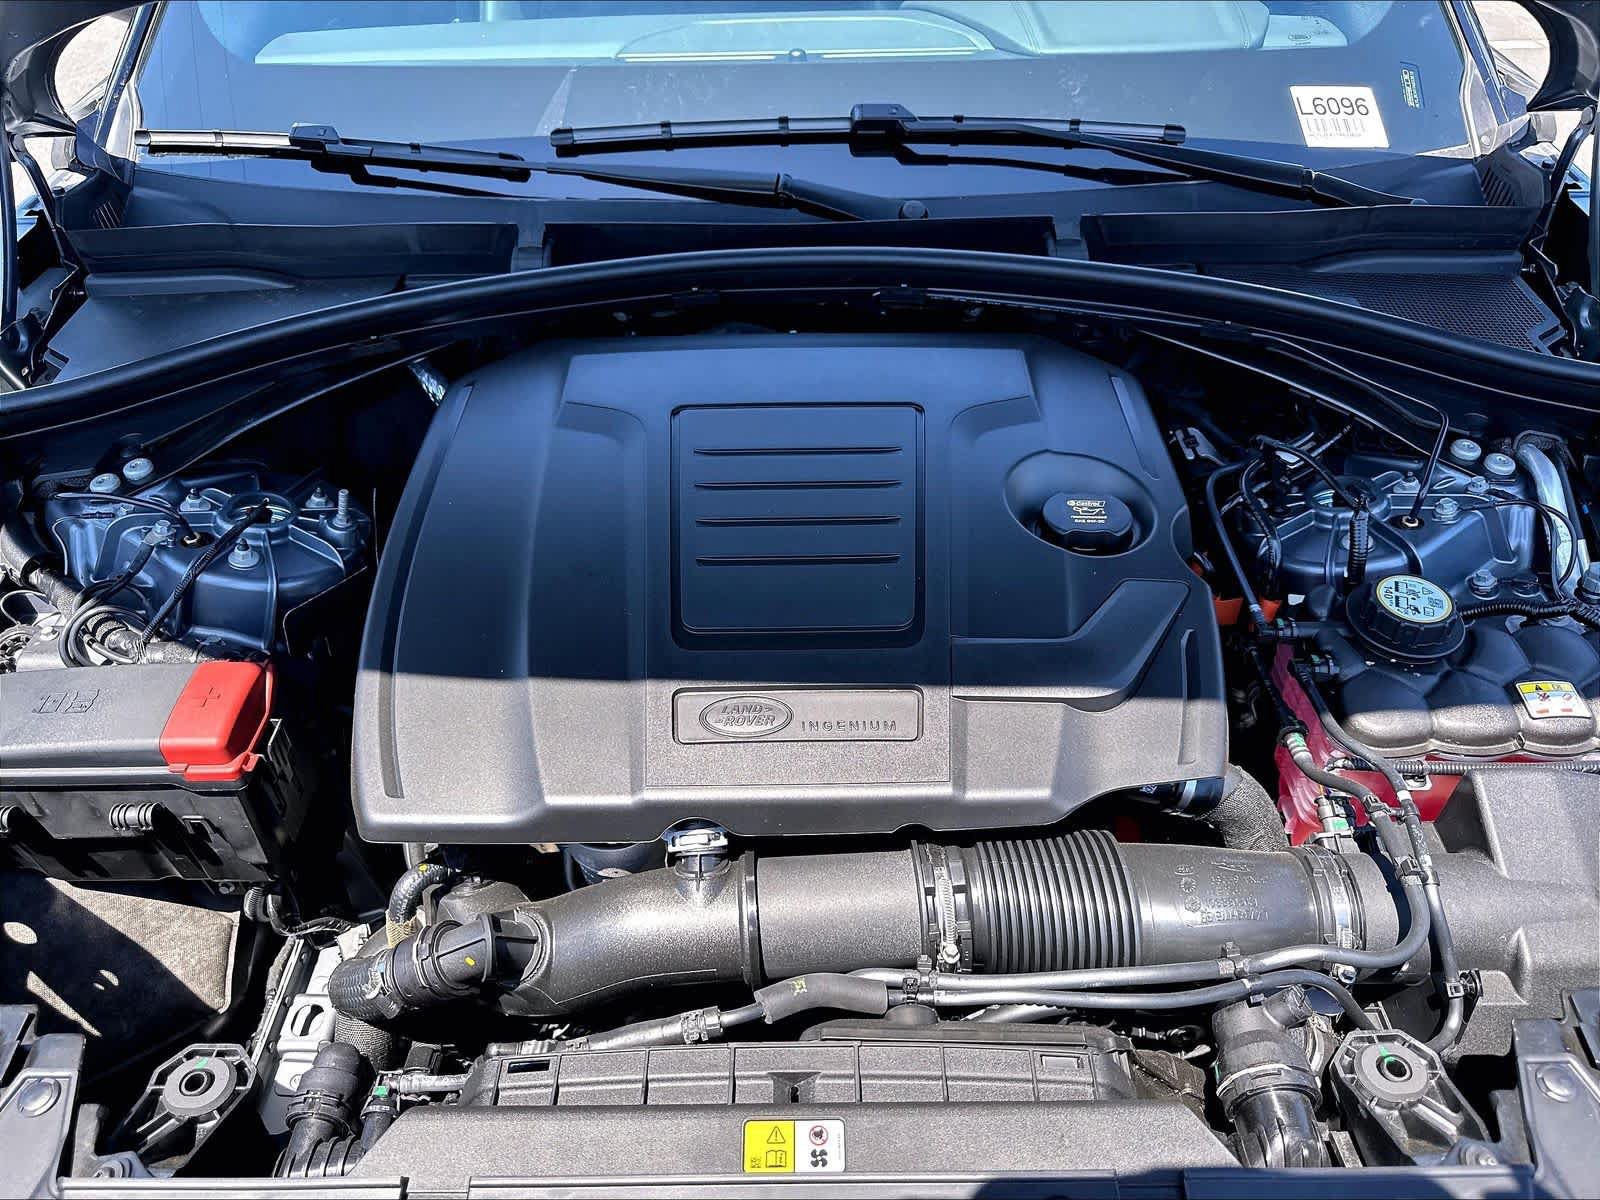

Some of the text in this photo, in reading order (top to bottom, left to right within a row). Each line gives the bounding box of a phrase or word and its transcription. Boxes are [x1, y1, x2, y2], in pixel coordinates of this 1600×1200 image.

[1296, 97, 1369, 116] L6096
[720, 704, 763, 714] LAND
[724, 715, 776, 727] ROVER
[801, 720, 897, 732] INGENIUM
